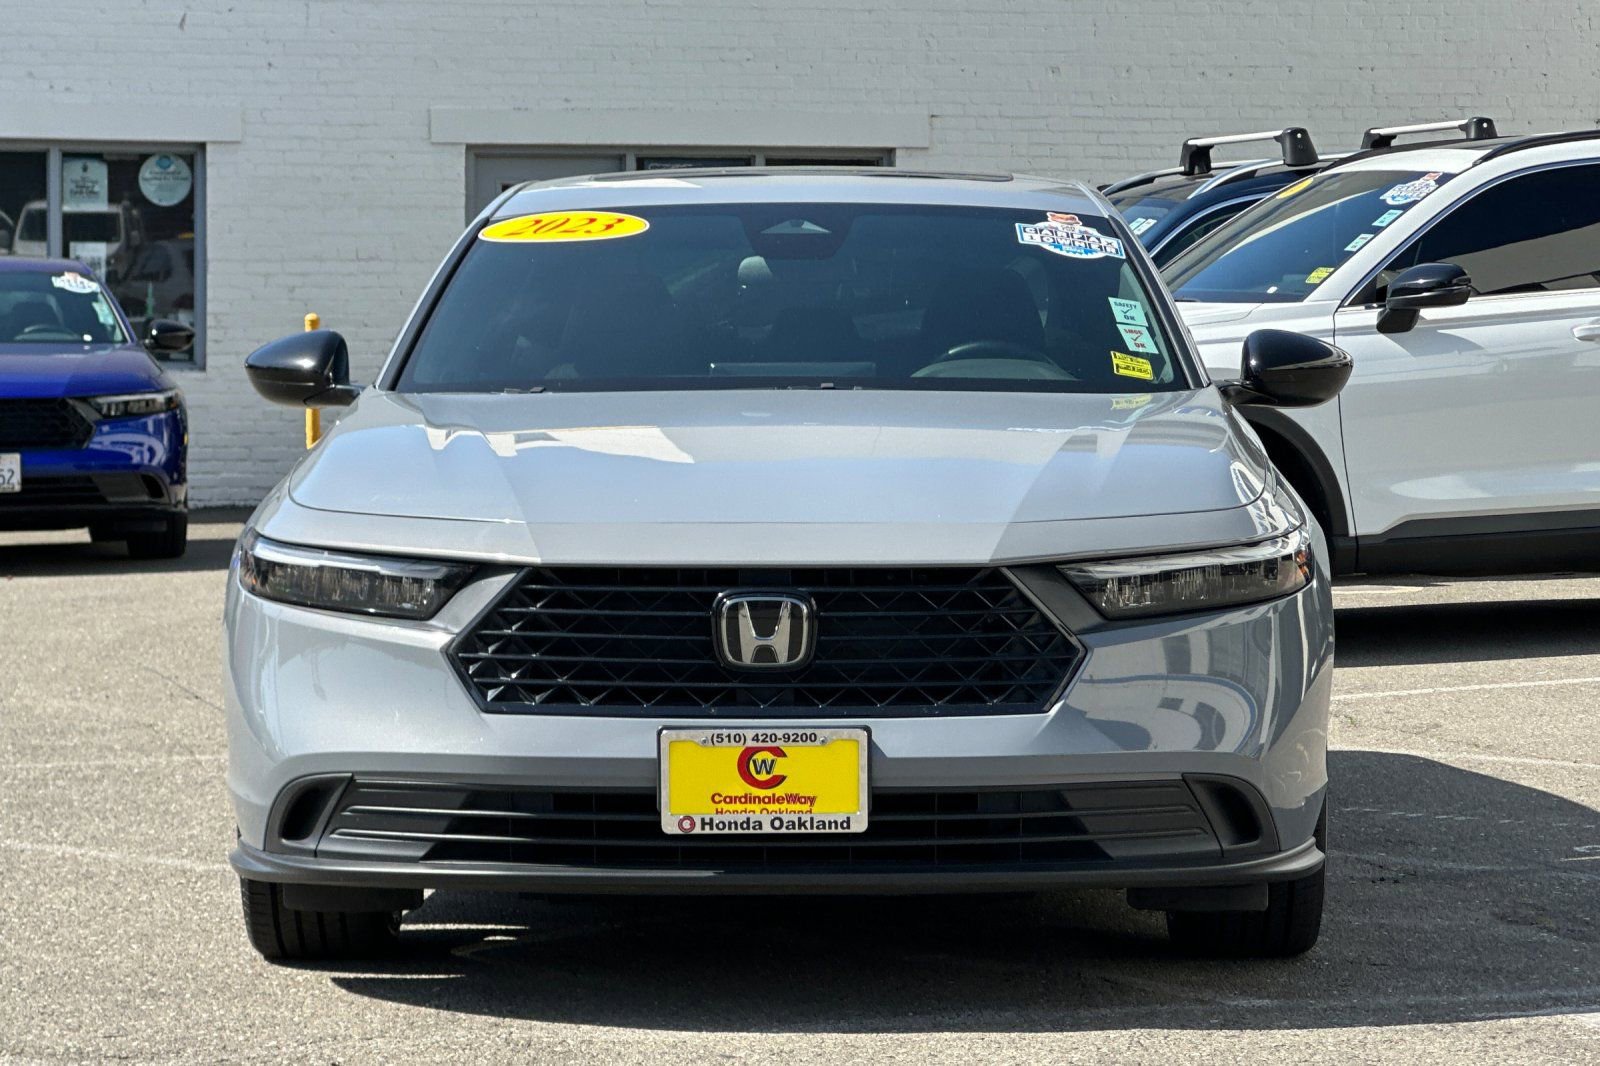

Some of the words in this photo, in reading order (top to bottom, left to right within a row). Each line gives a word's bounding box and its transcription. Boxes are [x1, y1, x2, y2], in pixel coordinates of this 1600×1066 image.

[501, 217, 626, 237] 2023
[1023, 227, 1116, 247] CARFAX
[710, 733, 747, 746] (510)
[752, 732, 818, 744] 420-9200
[710, 793, 817, 807] CardinaleWay
[700, 817, 763, 831] Honda
[770, 816, 851, 831] Oakland
